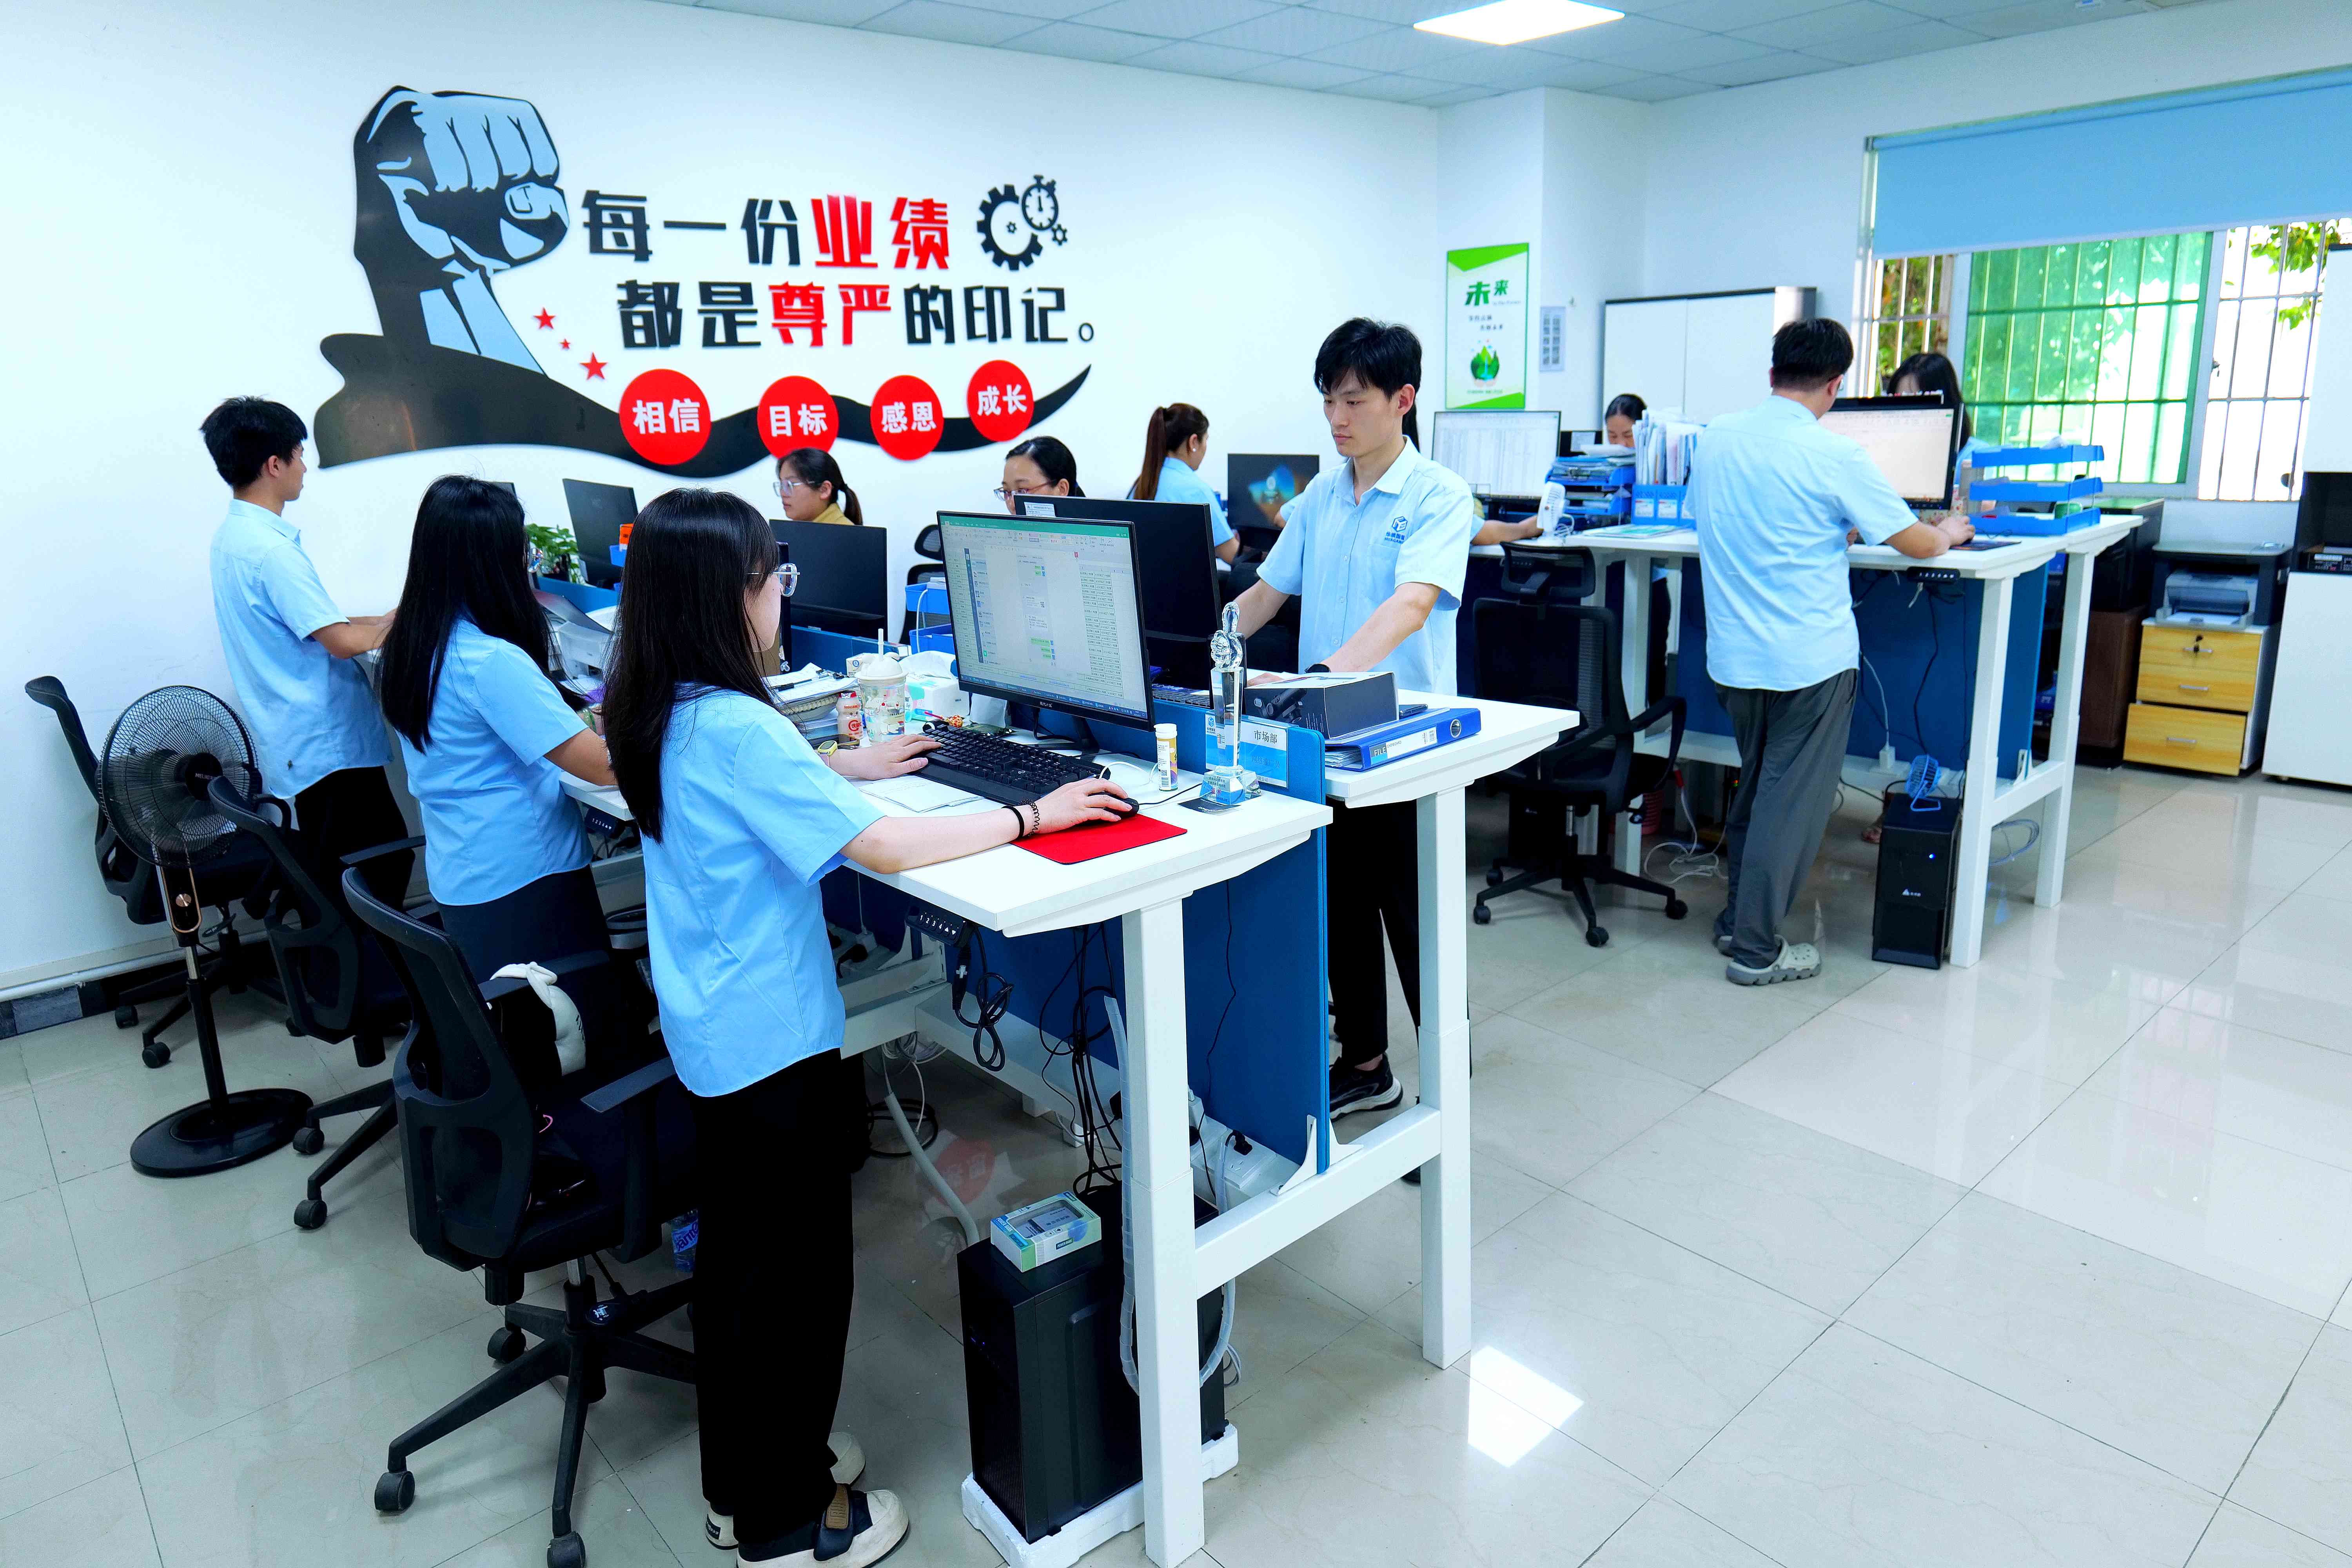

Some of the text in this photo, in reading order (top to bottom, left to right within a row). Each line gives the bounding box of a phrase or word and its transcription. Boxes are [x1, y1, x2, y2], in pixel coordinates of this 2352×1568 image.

[582, 190, 950, 270] 每一份业绩
[1465, 279, 1509, 306] 未来
[977, 383, 1027, 416] 成长
[633, 399, 701, 434] 相信
[769, 403, 828, 437] 目标
[881, 402, 936, 434] 感恩
[1254, 730, 1278, 744] 市场部
[1374, 747, 1386, 756] FILE
